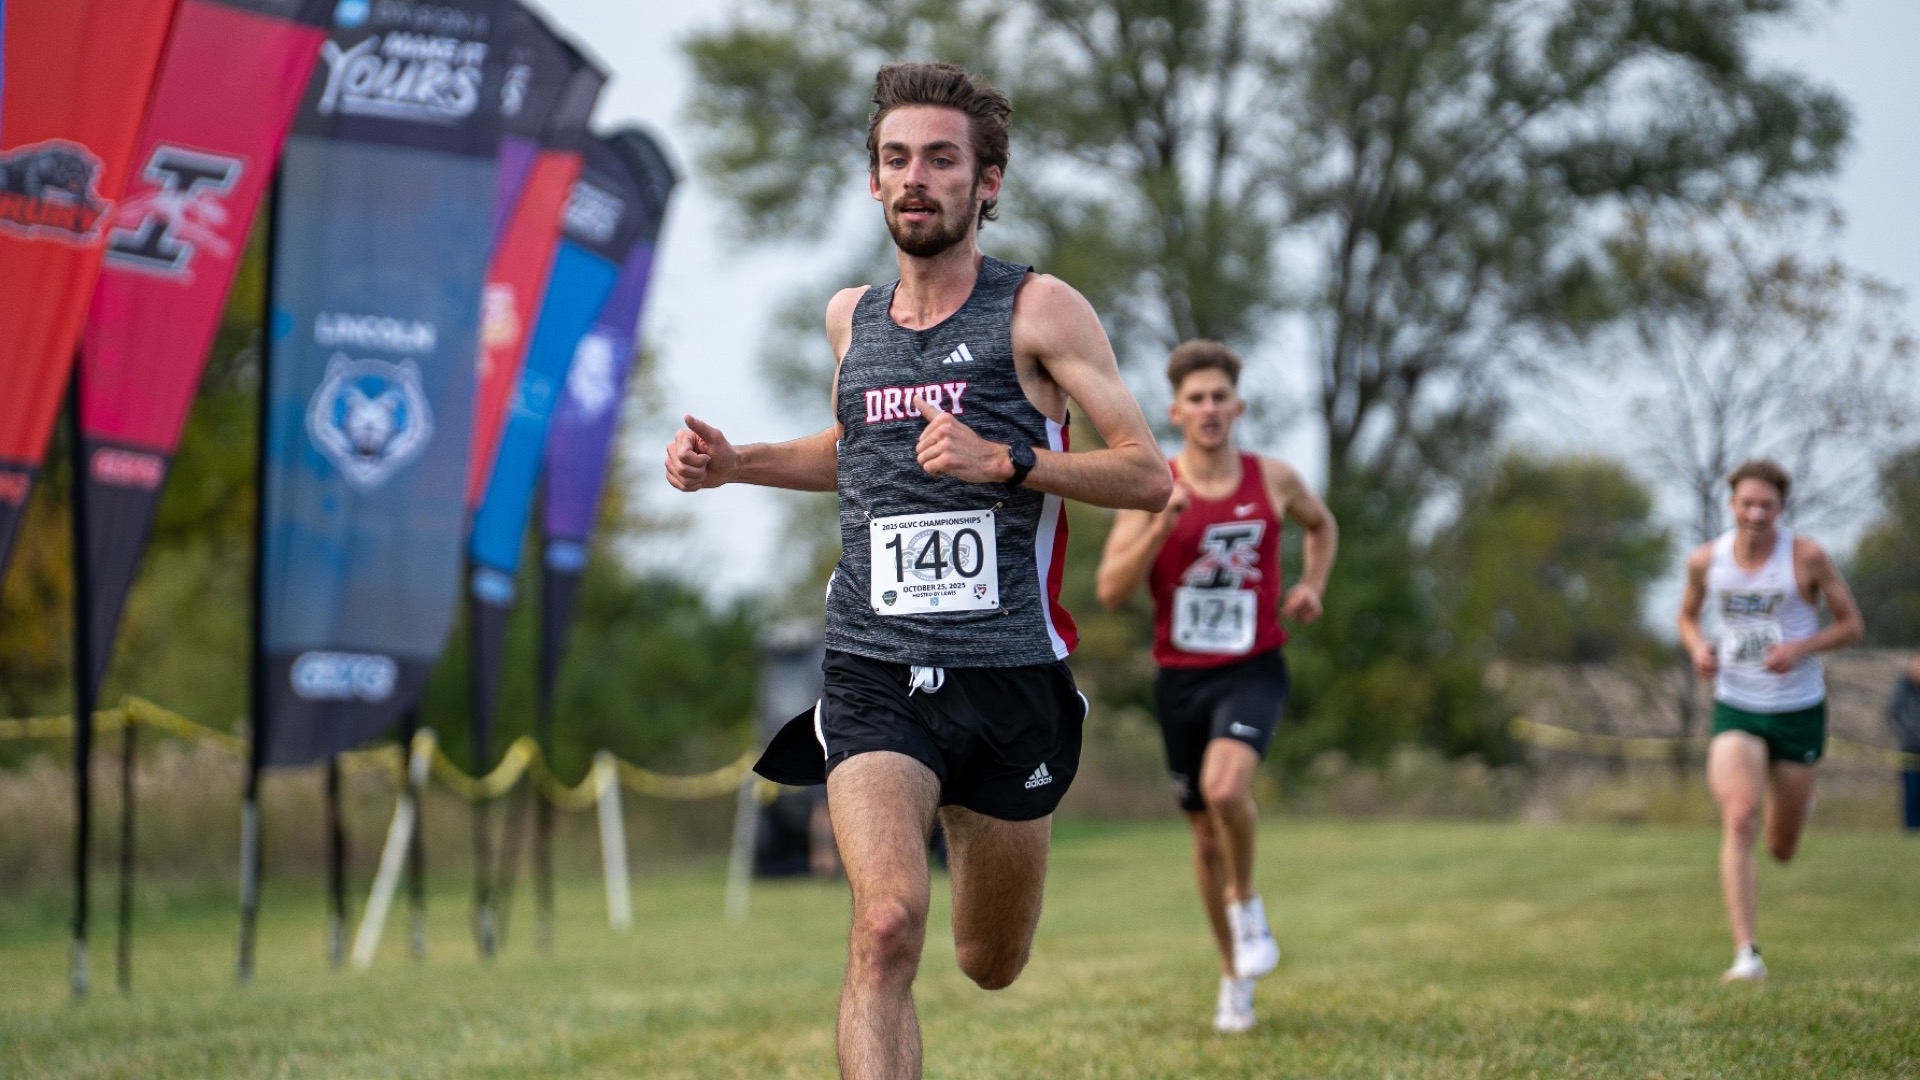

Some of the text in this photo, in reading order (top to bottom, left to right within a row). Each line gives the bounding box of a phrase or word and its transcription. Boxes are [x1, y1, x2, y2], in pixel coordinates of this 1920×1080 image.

[317, 34, 482, 118] YOURS
[314, 310, 437, 353] LINCOLN
[864, 380, 968, 424] DRURY
[882, 516, 981, 531] 2025 GLVC CHAMPIONSHIPS
[885, 527, 984, 583] 140
[903, 584, 936, 593] OCTOBER
[937, 583, 948, 592] 25,
[949, 582, 966, 590] 2025
[1188, 599, 1242, 629] 171
[1024, 775, 1053, 789] adidas
